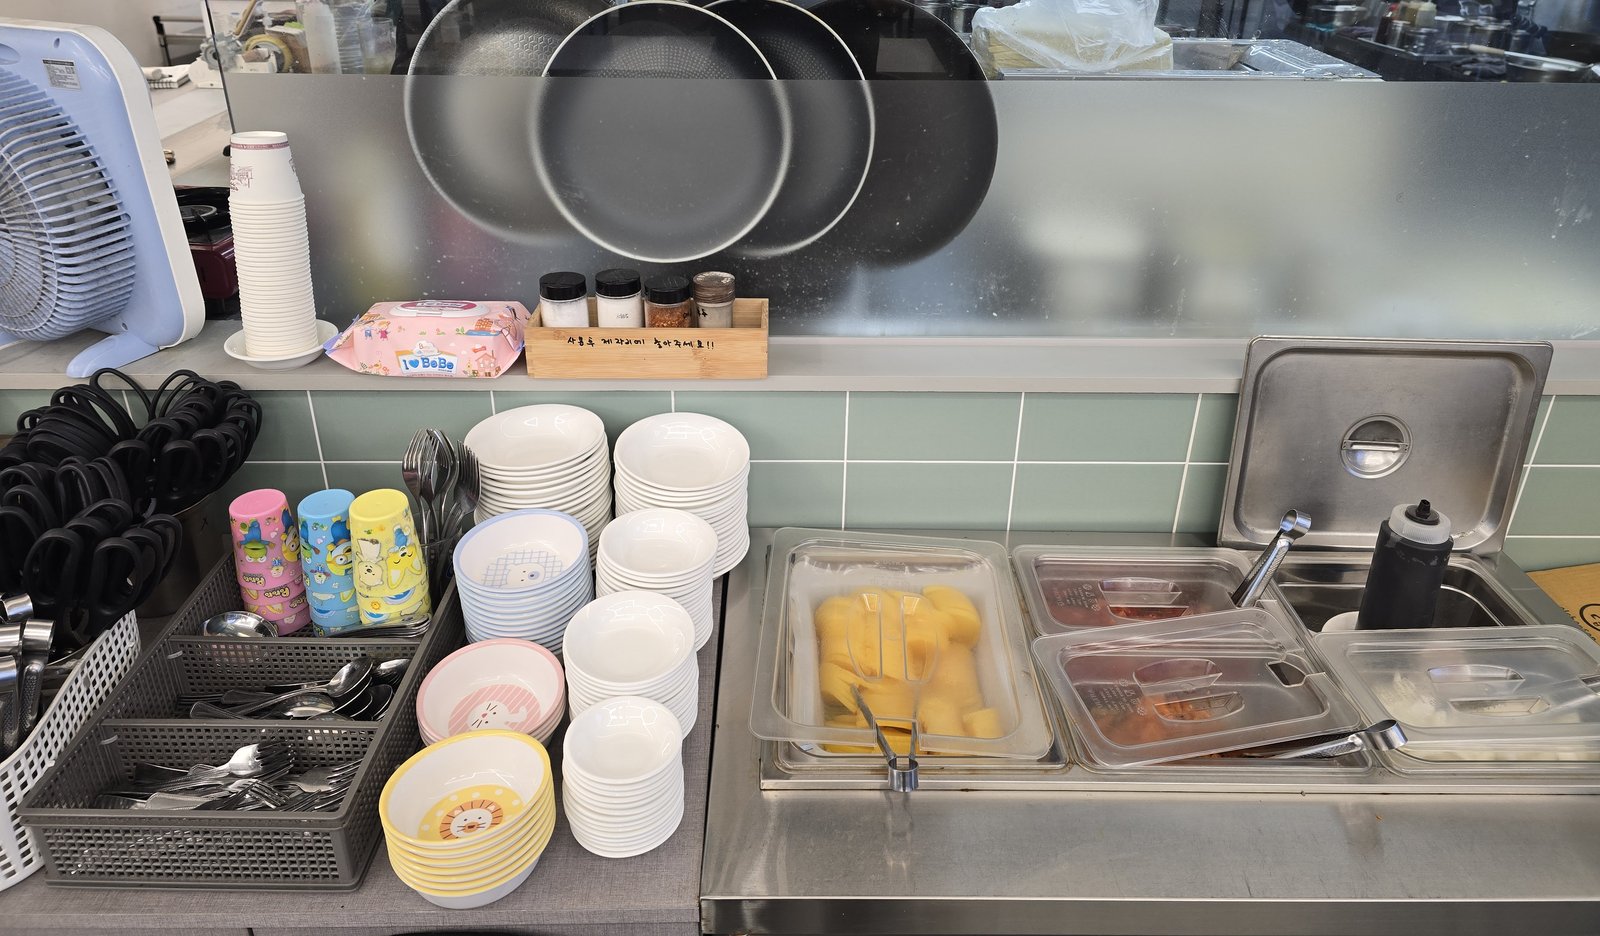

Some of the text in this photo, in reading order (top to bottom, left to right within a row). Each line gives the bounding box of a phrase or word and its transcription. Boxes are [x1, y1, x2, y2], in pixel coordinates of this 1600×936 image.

[567, 336, 714, 349] 사용후 제자리에 놓아주세요!!
[264, 586, 290, 598] Pororo
